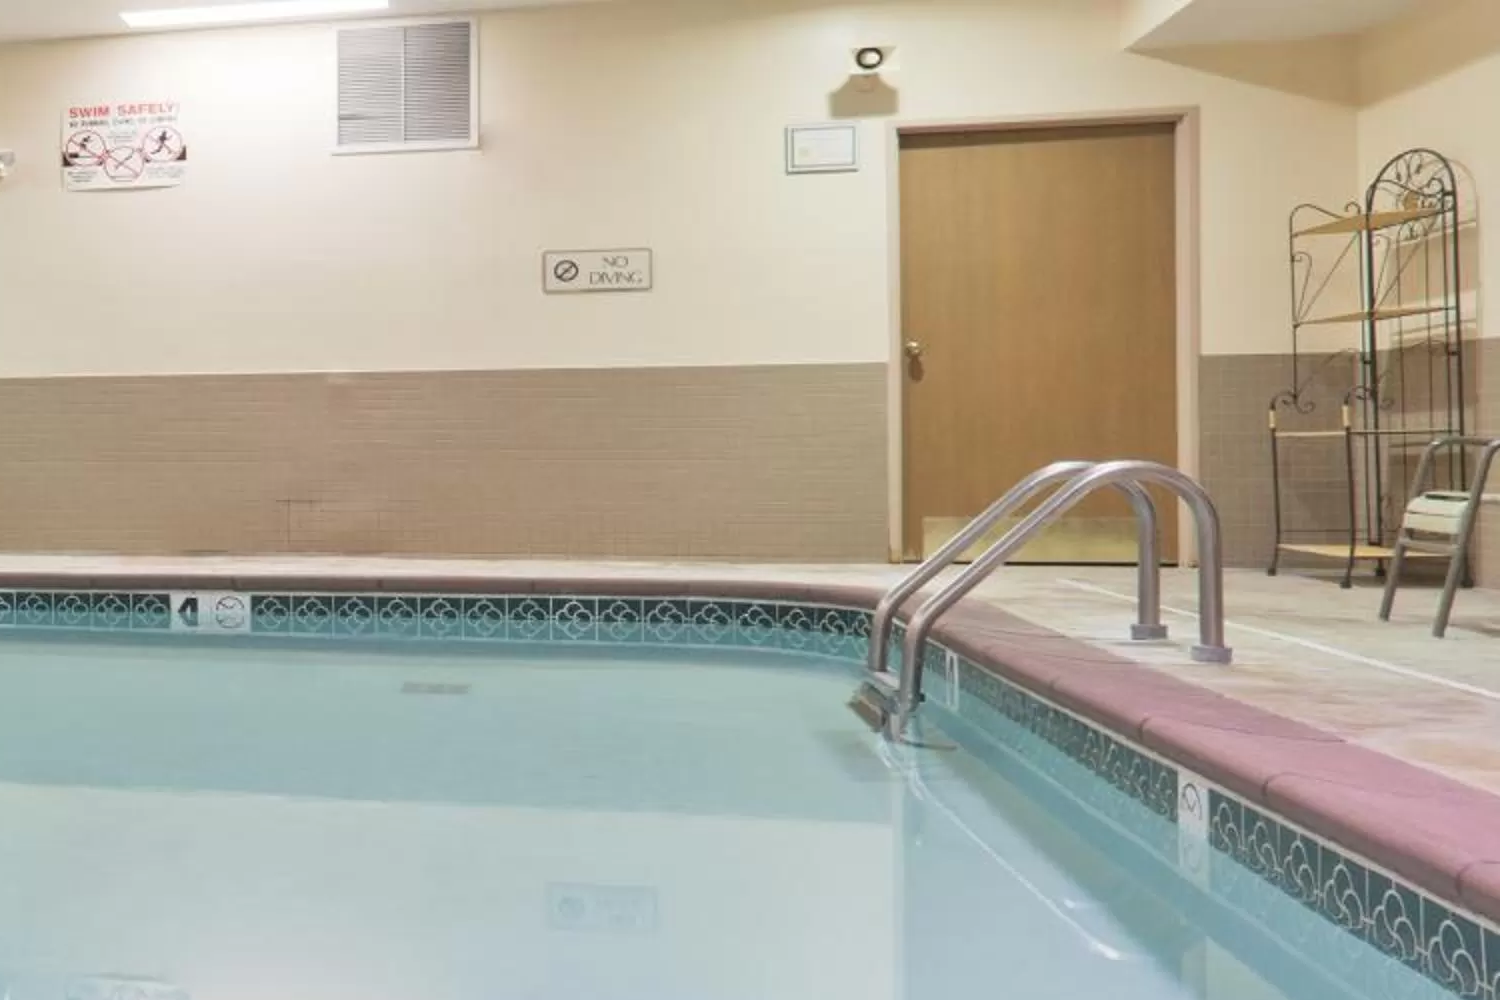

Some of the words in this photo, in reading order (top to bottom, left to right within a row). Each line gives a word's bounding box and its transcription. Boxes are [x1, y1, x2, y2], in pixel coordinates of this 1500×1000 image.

[68, 105, 110, 119] SWIM
[602, 255, 629, 268] NO
[589, 269, 643, 285] DIVING
